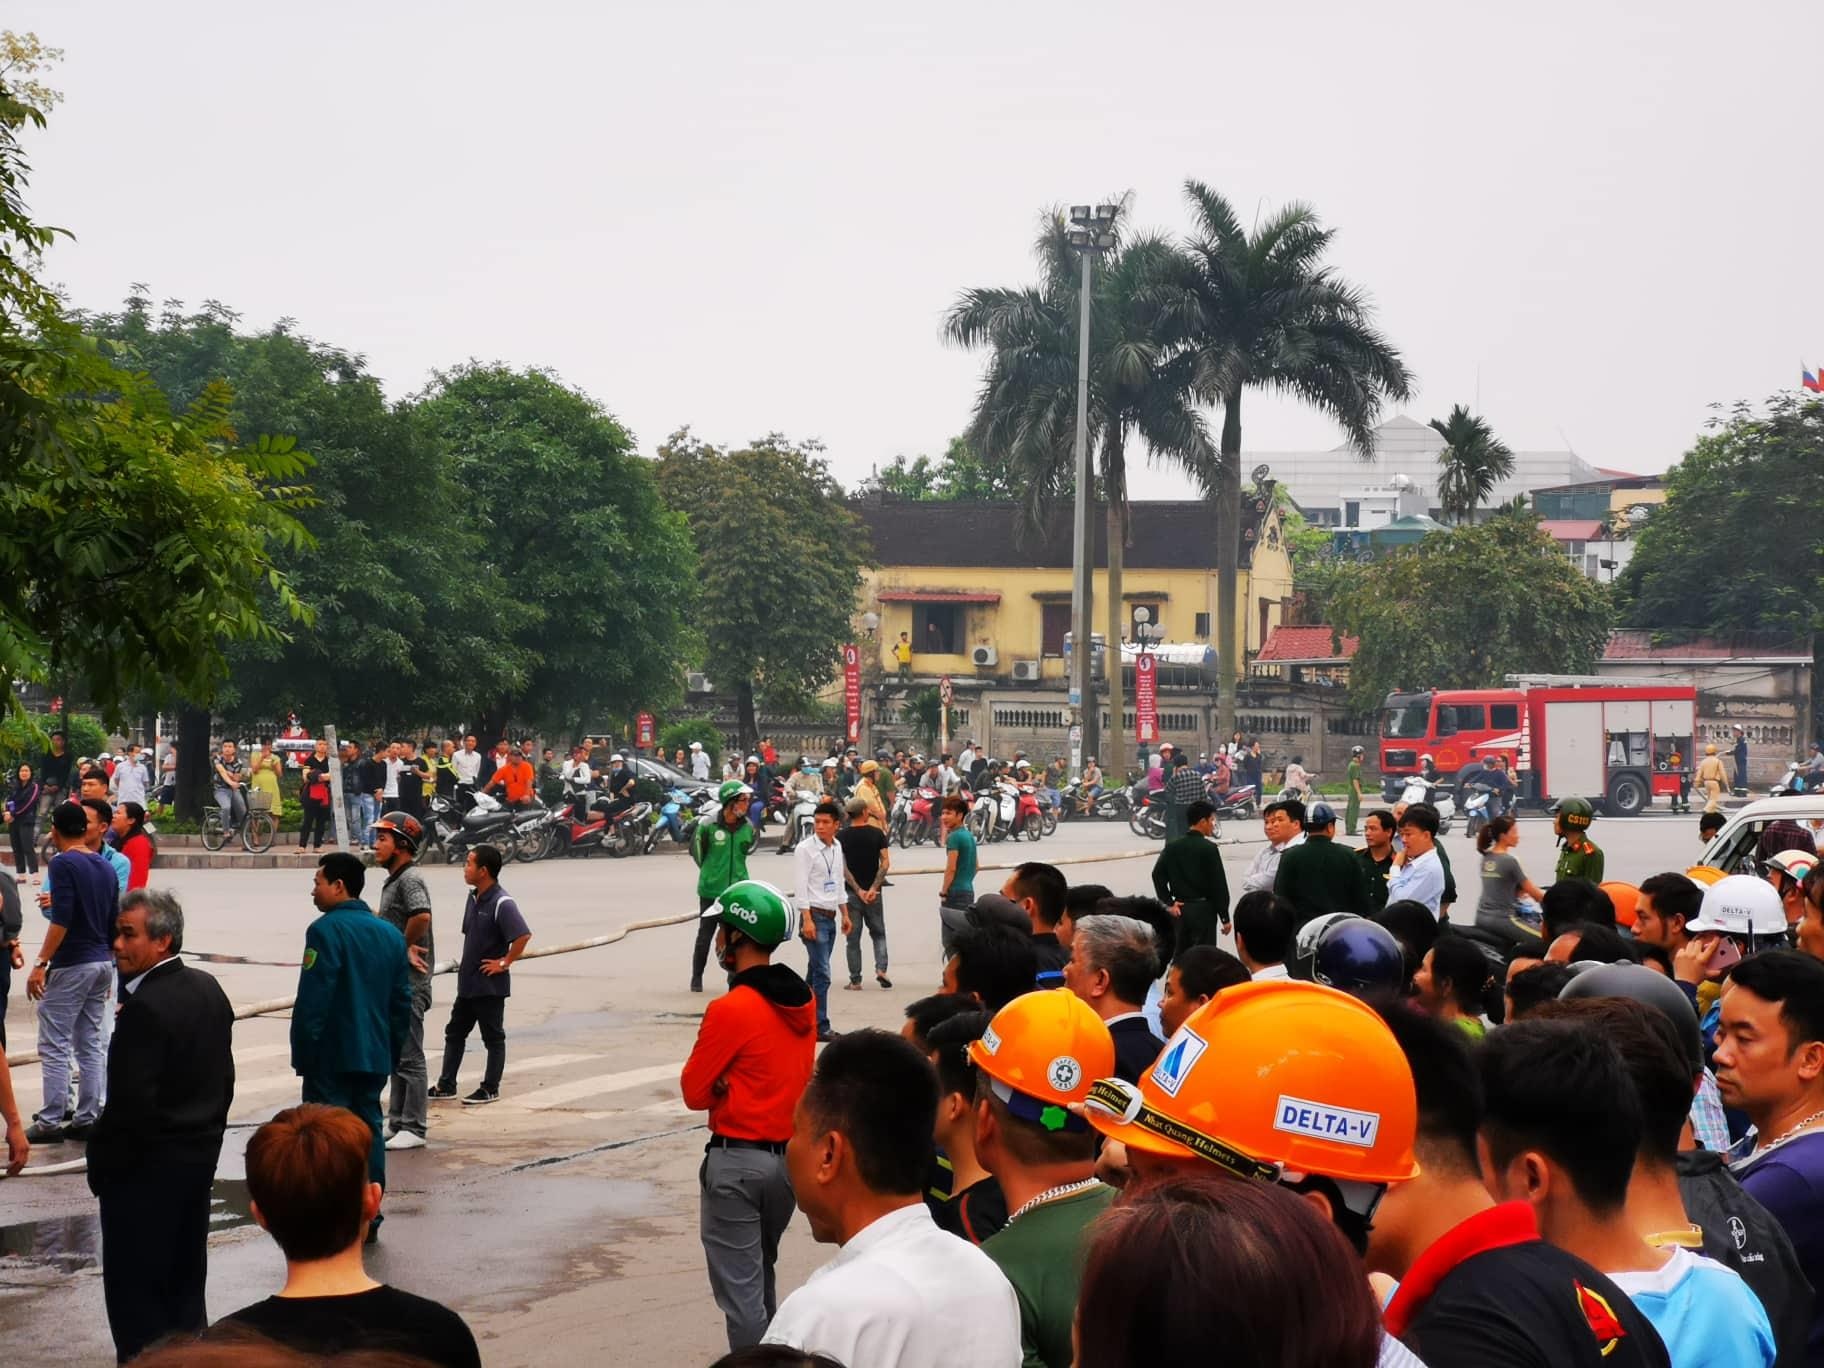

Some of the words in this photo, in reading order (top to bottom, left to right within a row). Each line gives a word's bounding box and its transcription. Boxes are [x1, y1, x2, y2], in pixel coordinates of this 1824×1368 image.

[729, 902, 758, 924] Grab
[1282, 1105, 1372, 1139] DELTA-V
[1164, 1123, 1195, 1146] Quang
[1194, 1137, 1236, 1165] Helmets
